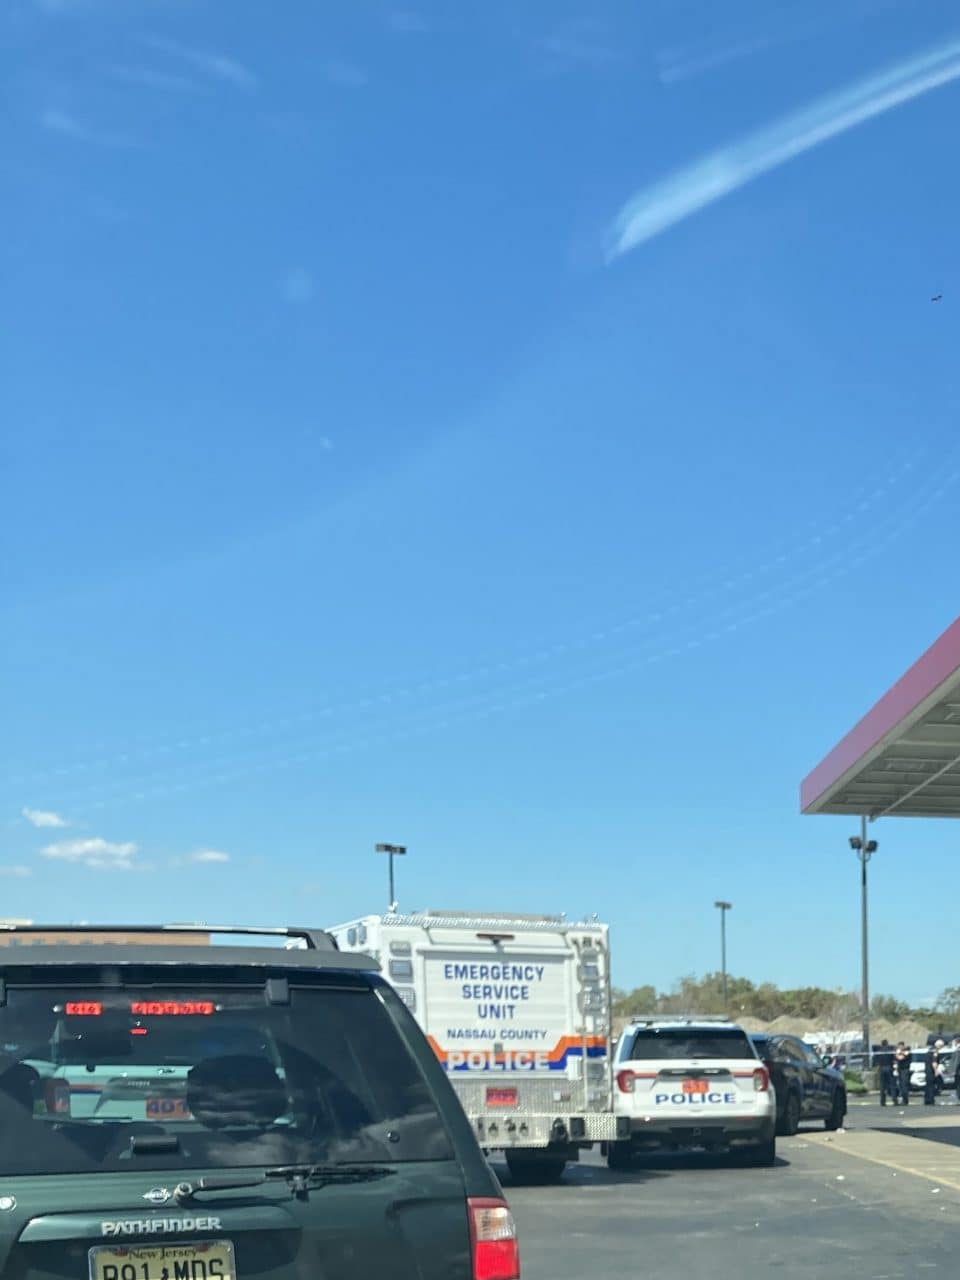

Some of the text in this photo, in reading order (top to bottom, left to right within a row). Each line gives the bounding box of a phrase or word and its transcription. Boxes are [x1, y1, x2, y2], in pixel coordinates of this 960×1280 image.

[444, 963, 545, 981] EMERGENCY
[462, 985, 529, 1001] SERVICE
[477, 1004, 516, 1020] UNIT
[447, 1028, 548, 1040] NASSAU COUNTY
[447, 1050, 551, 1071] POLICE
[655, 1092, 736, 1105] POLICE
[101, 1216, 223, 1237] PATHFINDER
